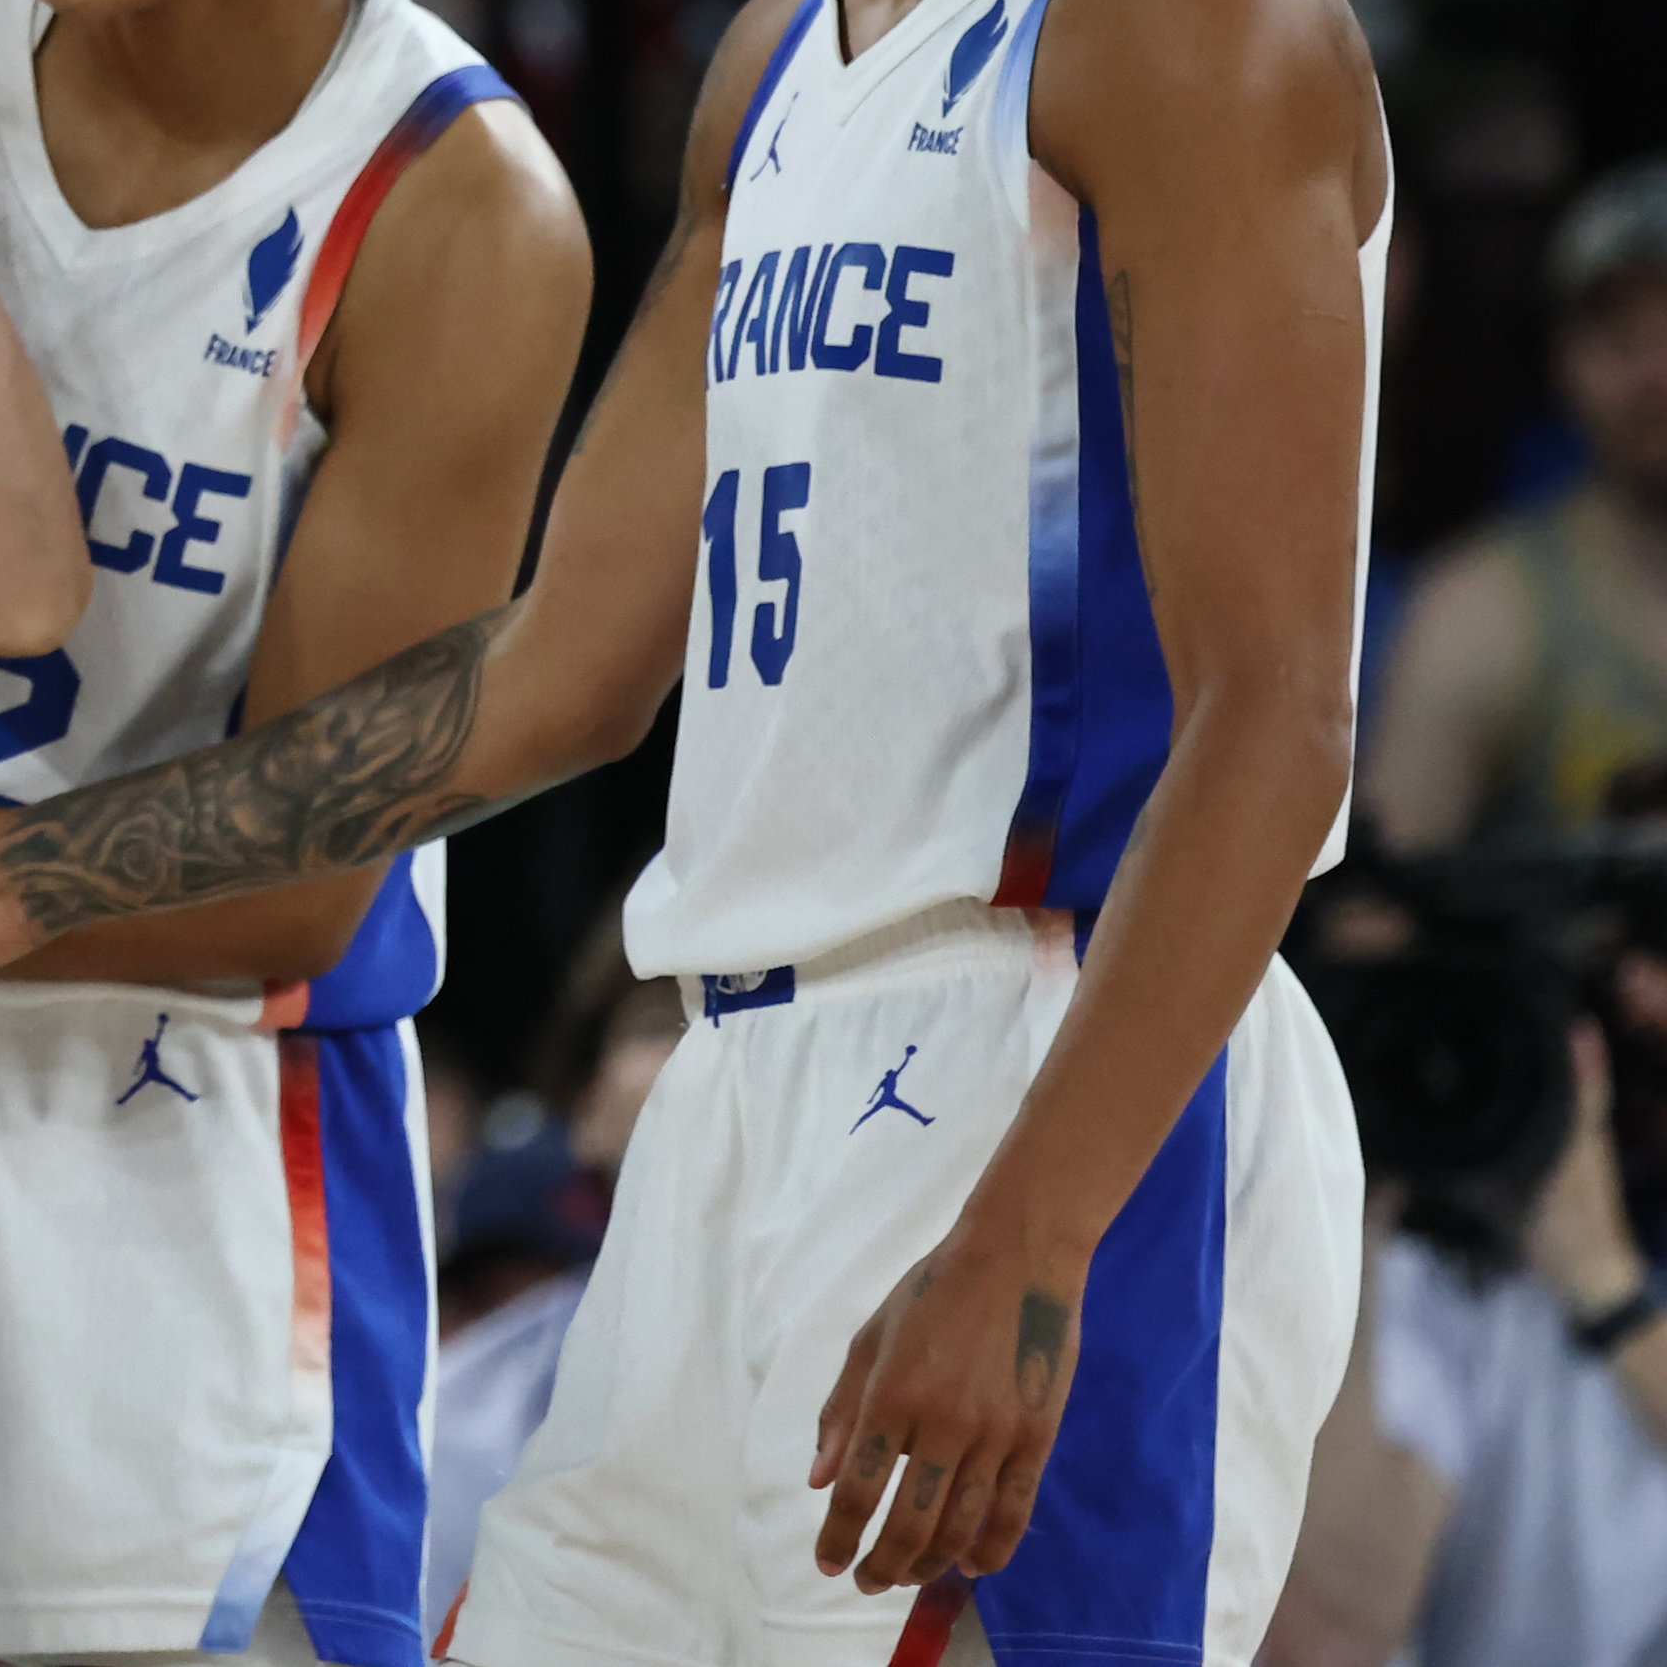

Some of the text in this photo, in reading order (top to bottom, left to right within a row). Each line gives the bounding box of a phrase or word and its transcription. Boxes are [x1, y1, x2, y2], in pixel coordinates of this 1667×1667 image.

[907, 122, 964, 156] FRANCE
[204, 333, 276, 377] FRANCE
[706, 242, 955, 386] RANCE
[702, 462, 811, 689] 15
